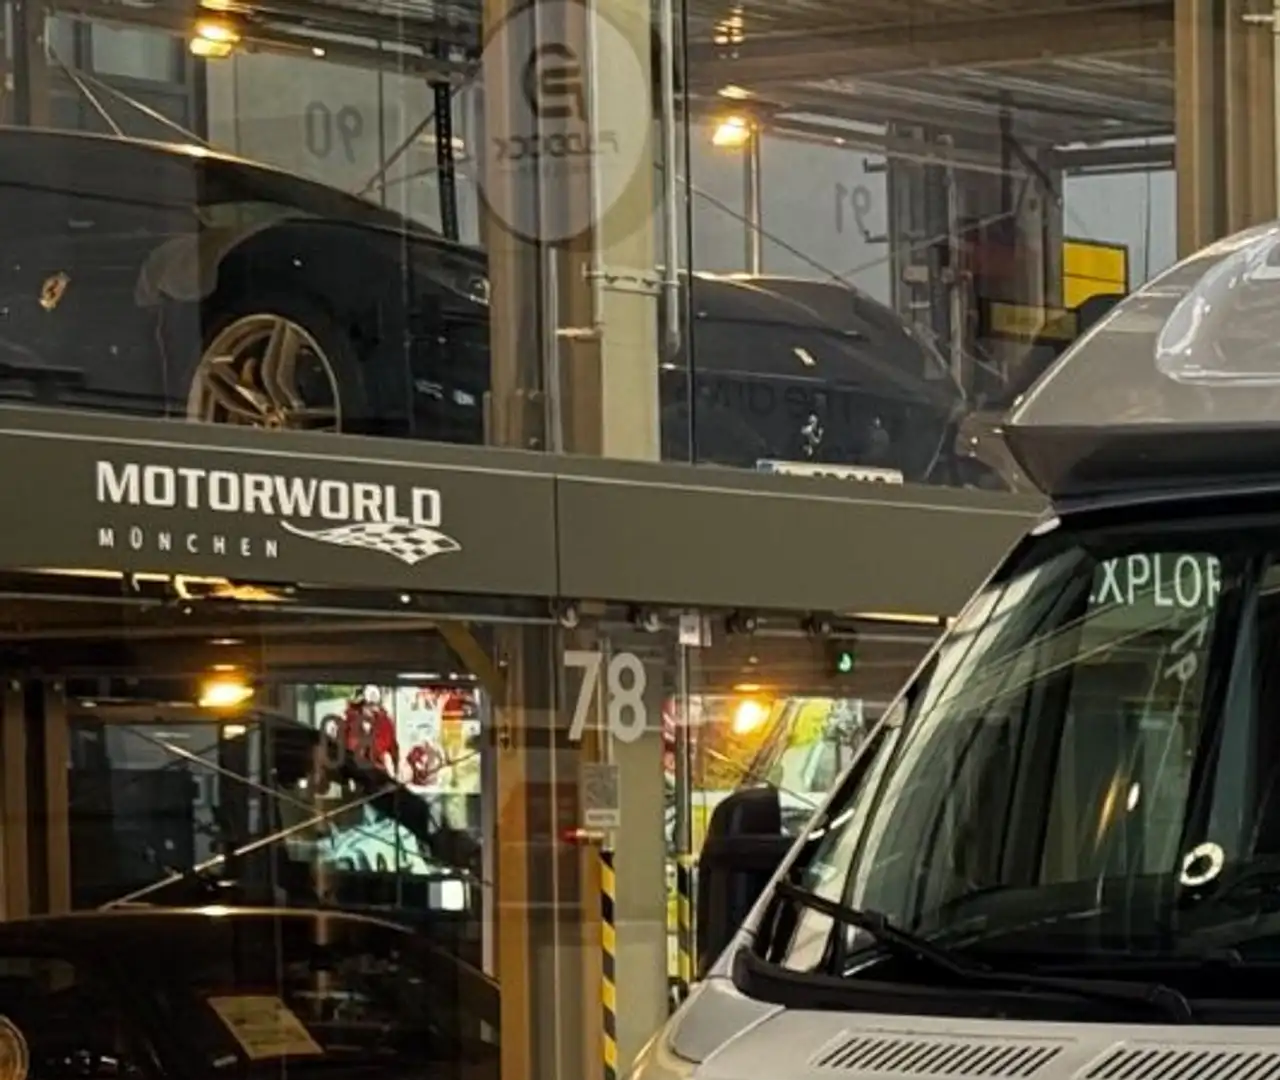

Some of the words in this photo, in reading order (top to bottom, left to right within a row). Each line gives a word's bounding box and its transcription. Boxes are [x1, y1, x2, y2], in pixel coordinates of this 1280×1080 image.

[96, 460, 442, 528] MOTORWORLD
[99, 525, 279, 559] MÜNCHEN
[563, 650, 647, 743] 78
